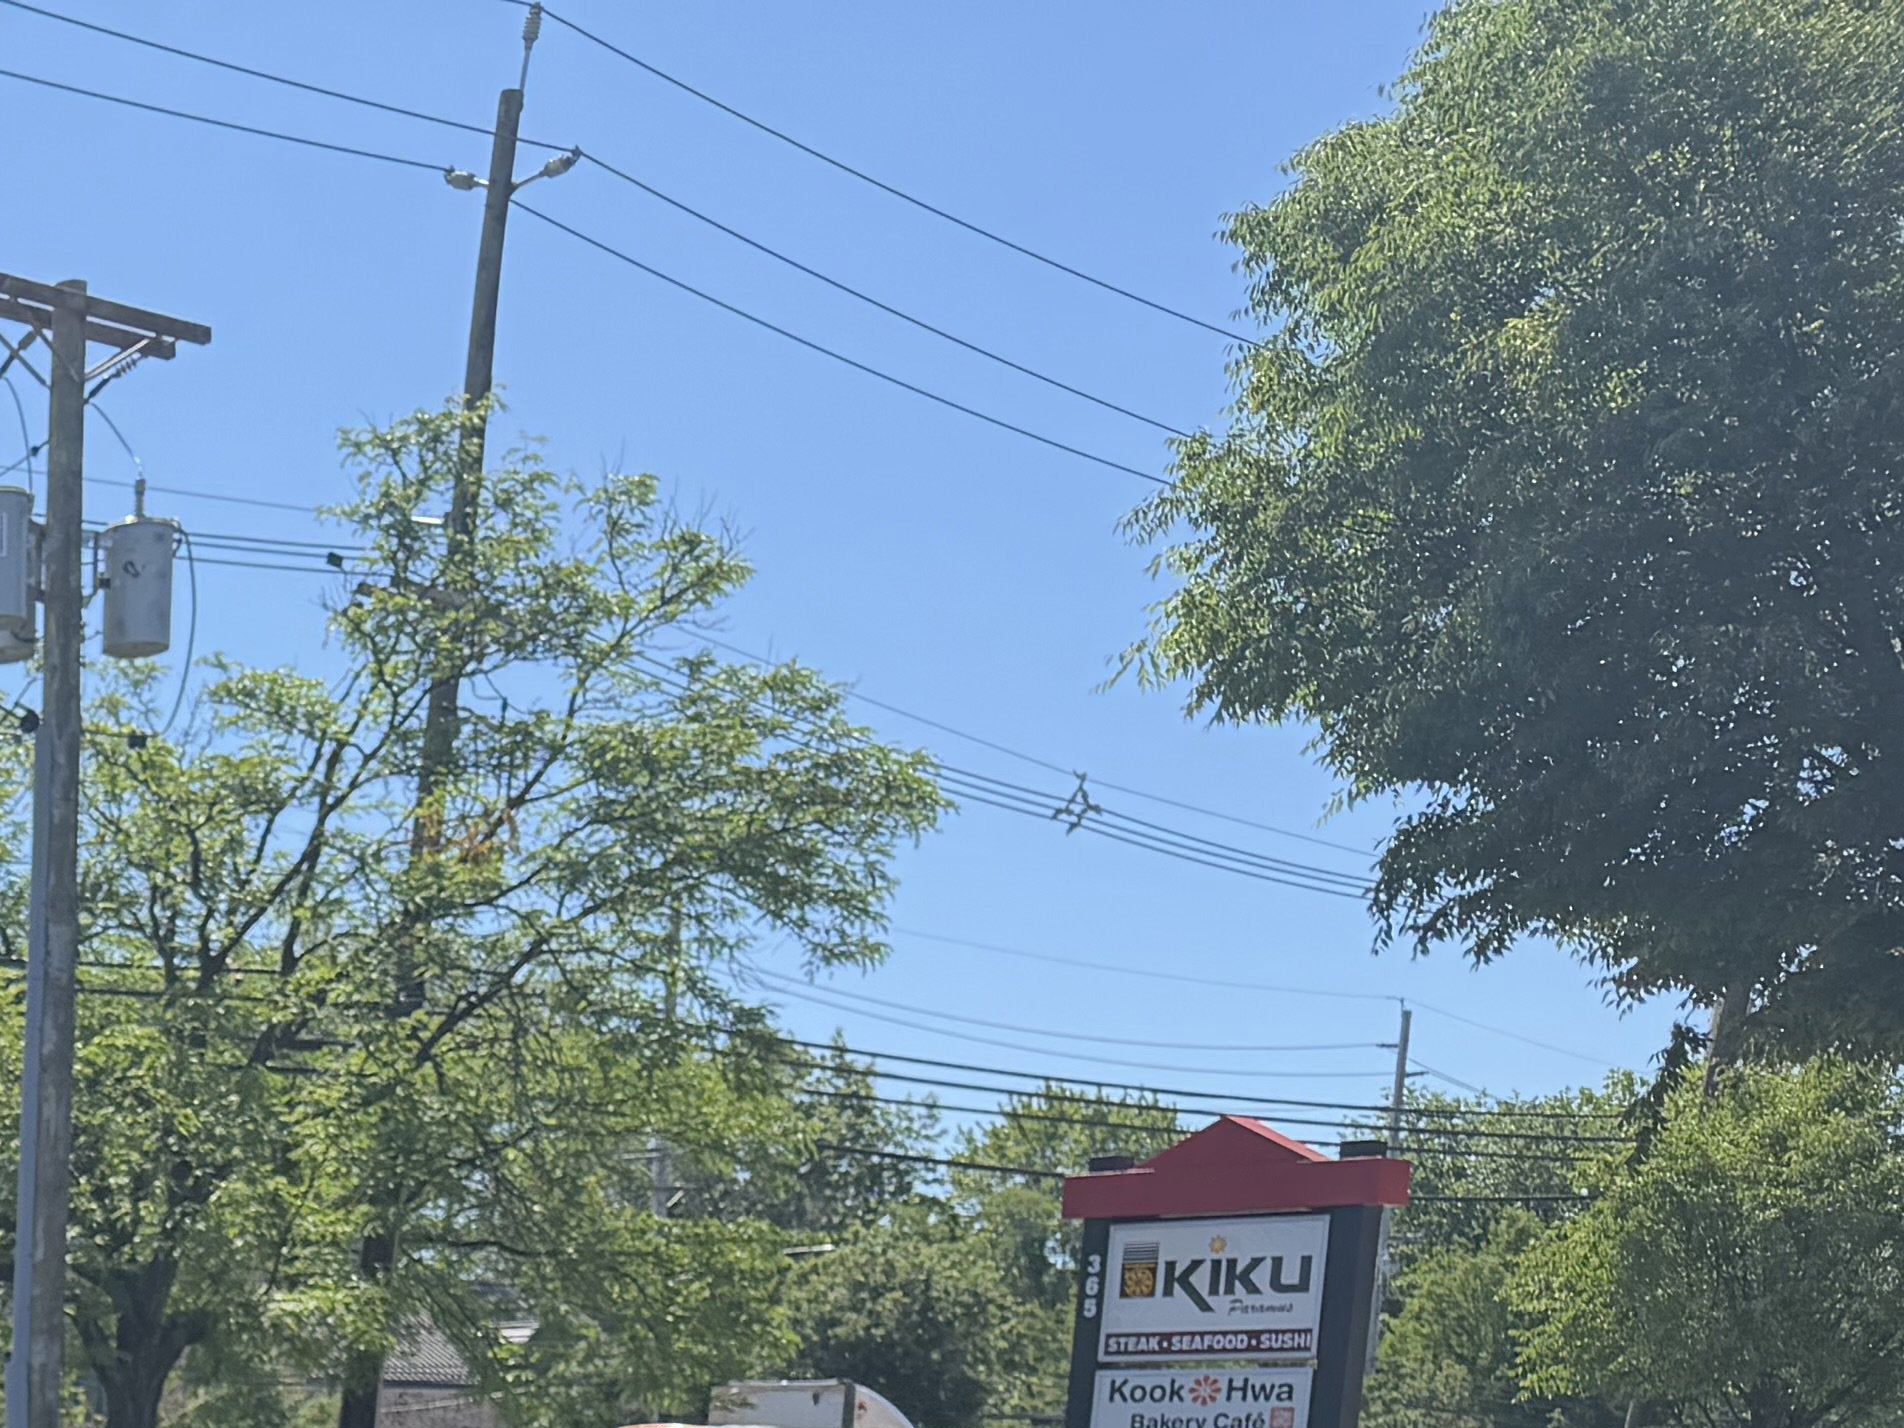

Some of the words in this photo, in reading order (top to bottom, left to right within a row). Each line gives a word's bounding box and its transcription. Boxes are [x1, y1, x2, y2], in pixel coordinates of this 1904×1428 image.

[1162, 1253, 1313, 1313] KIKU
[1108, 1336, 1160, 1352] STEAK
[1171, 1334, 1248, 1351] SEAFOOD
[1259, 1332, 1312, 1349] SUSHI
[1109, 1378, 1185, 1403] Kook
[1226, 1377, 1294, 1402] Hwa
